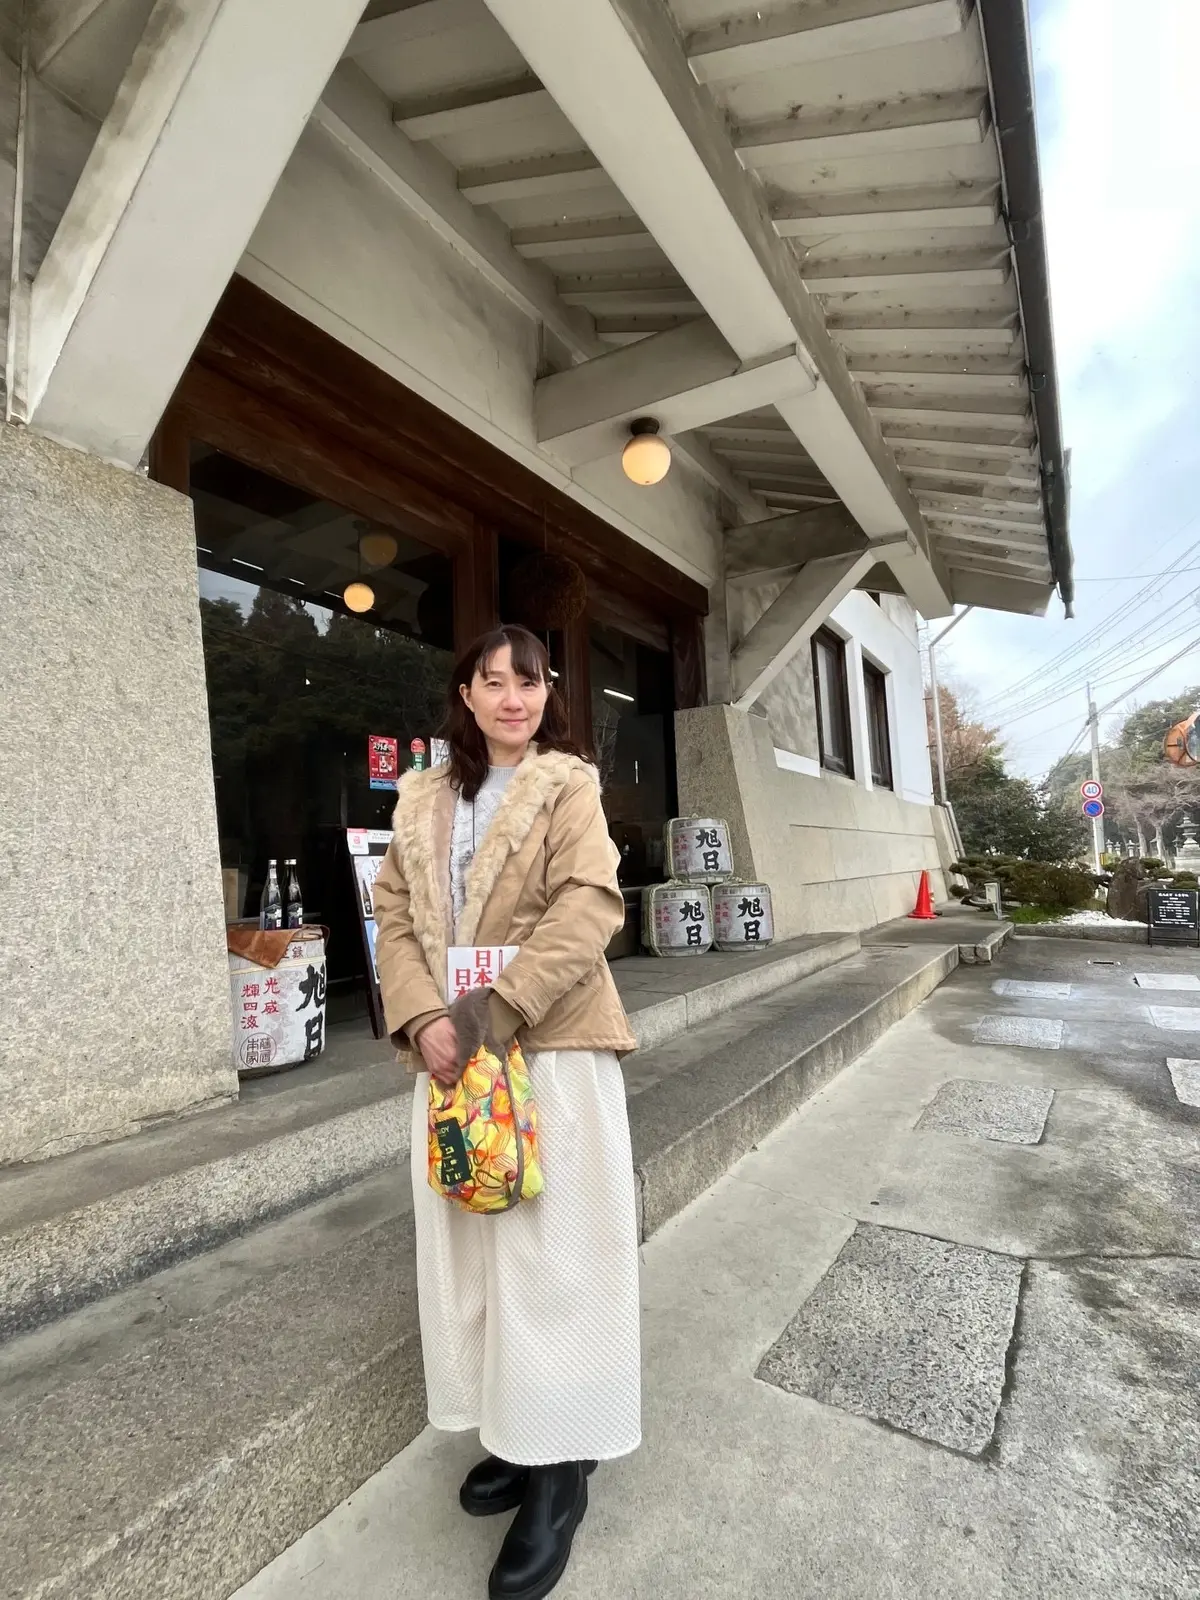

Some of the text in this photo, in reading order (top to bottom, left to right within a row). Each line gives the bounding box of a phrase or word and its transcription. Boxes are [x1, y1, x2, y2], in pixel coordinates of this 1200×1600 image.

[1086, 786, 1097, 794] 40
[695, 829, 722, 871] 旭日
[679, 901, 705, 945] 旭日
[737, 897, 764, 941] 旭日
[473, 950, 493, 988] 日本
[261, 976, 281, 1015] 光威
[295, 964, 326, 1062] 旭日
